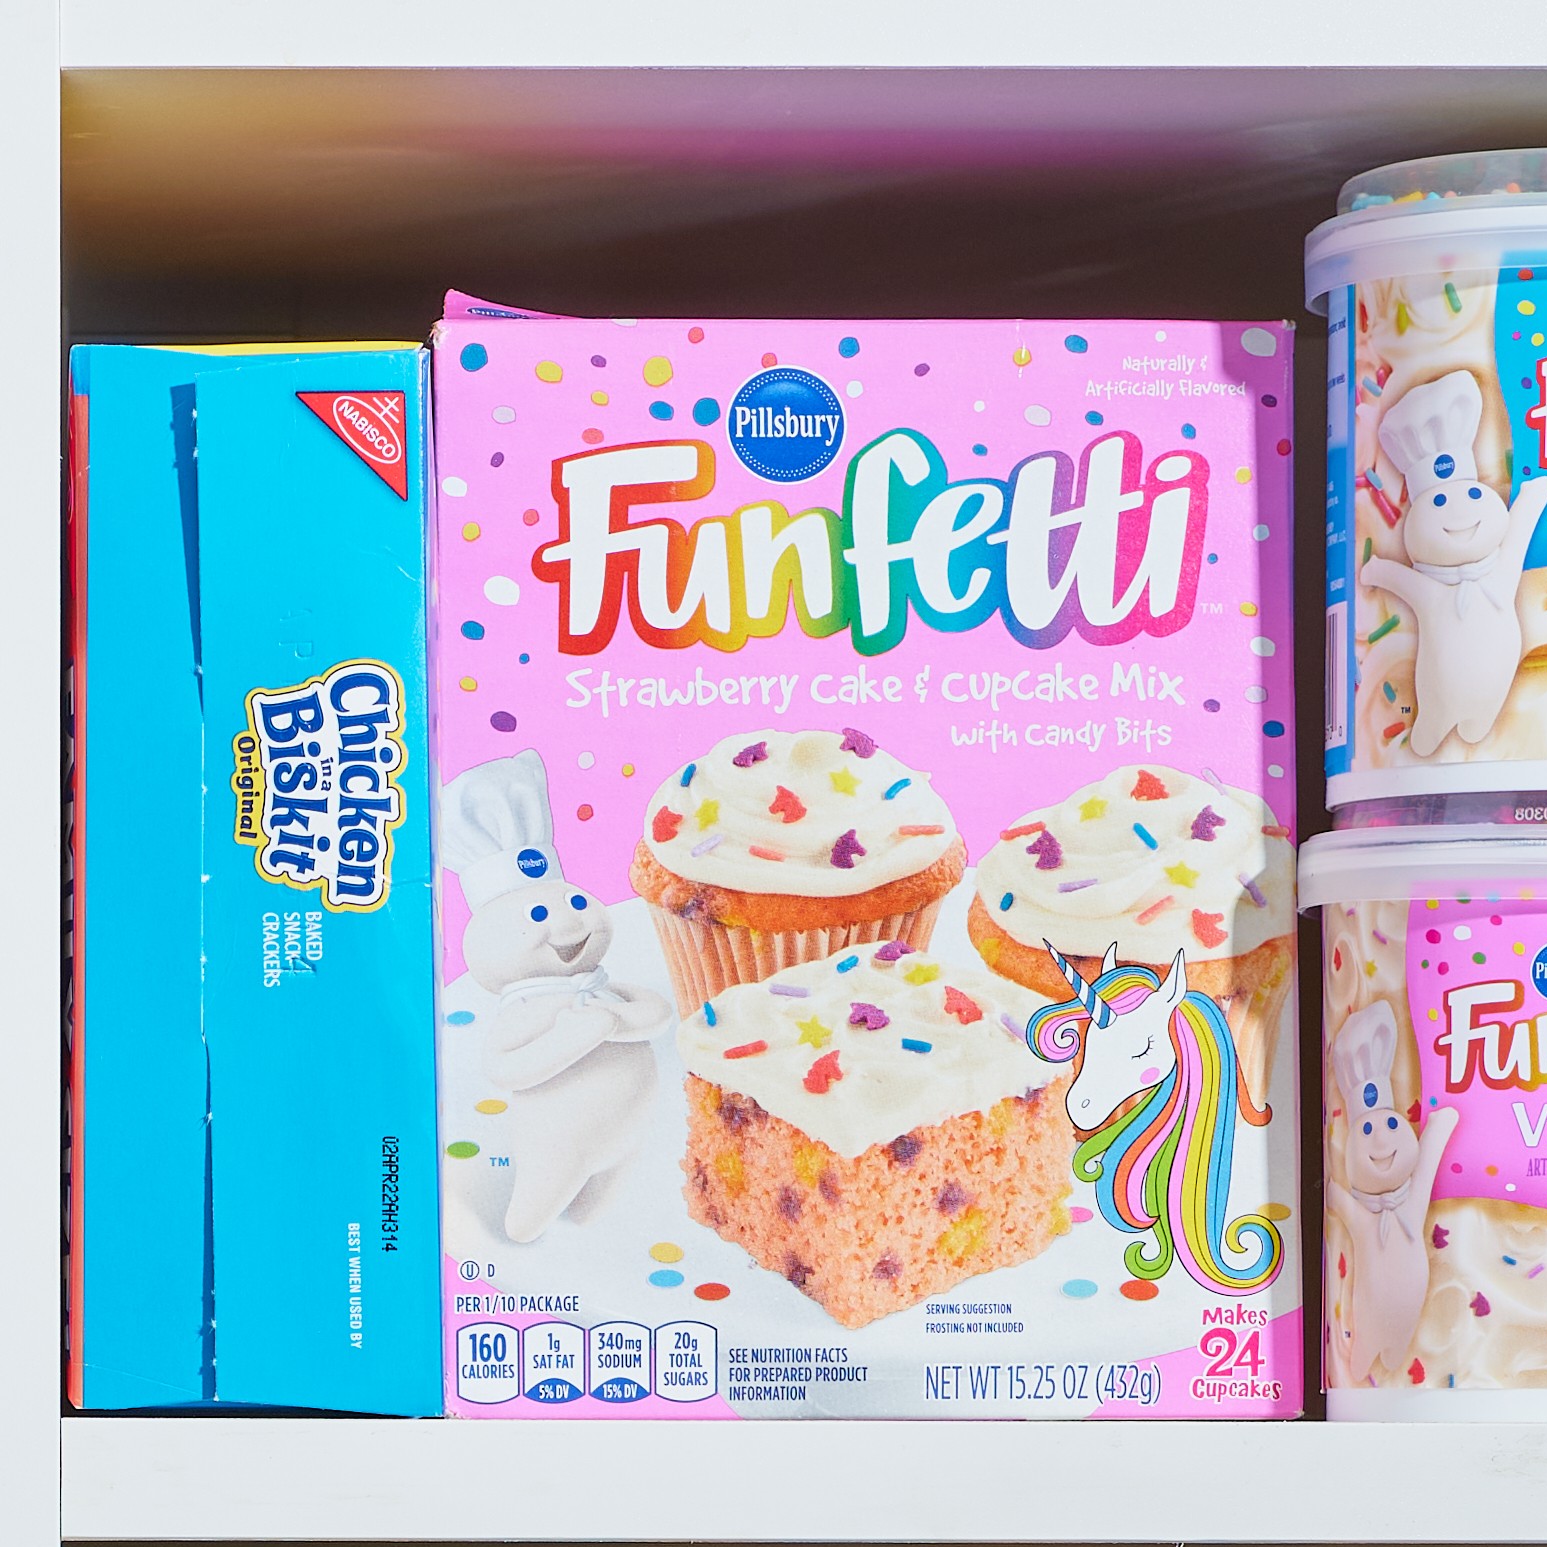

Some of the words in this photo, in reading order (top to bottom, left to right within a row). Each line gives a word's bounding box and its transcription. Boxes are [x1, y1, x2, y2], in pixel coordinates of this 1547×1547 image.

[533, 429, 1210, 655] Funfetti
[260, 690, 326, 875] Biskit
[950, 720, 1019, 748] with
[1116, 717, 1171, 747] Bits
[234, 735, 258, 839] Original
[330, 673, 395, 902] Chicken
[262, 911, 281, 989] CRACKERS
[1192, 1376, 1282, 1401] Cupcakes
